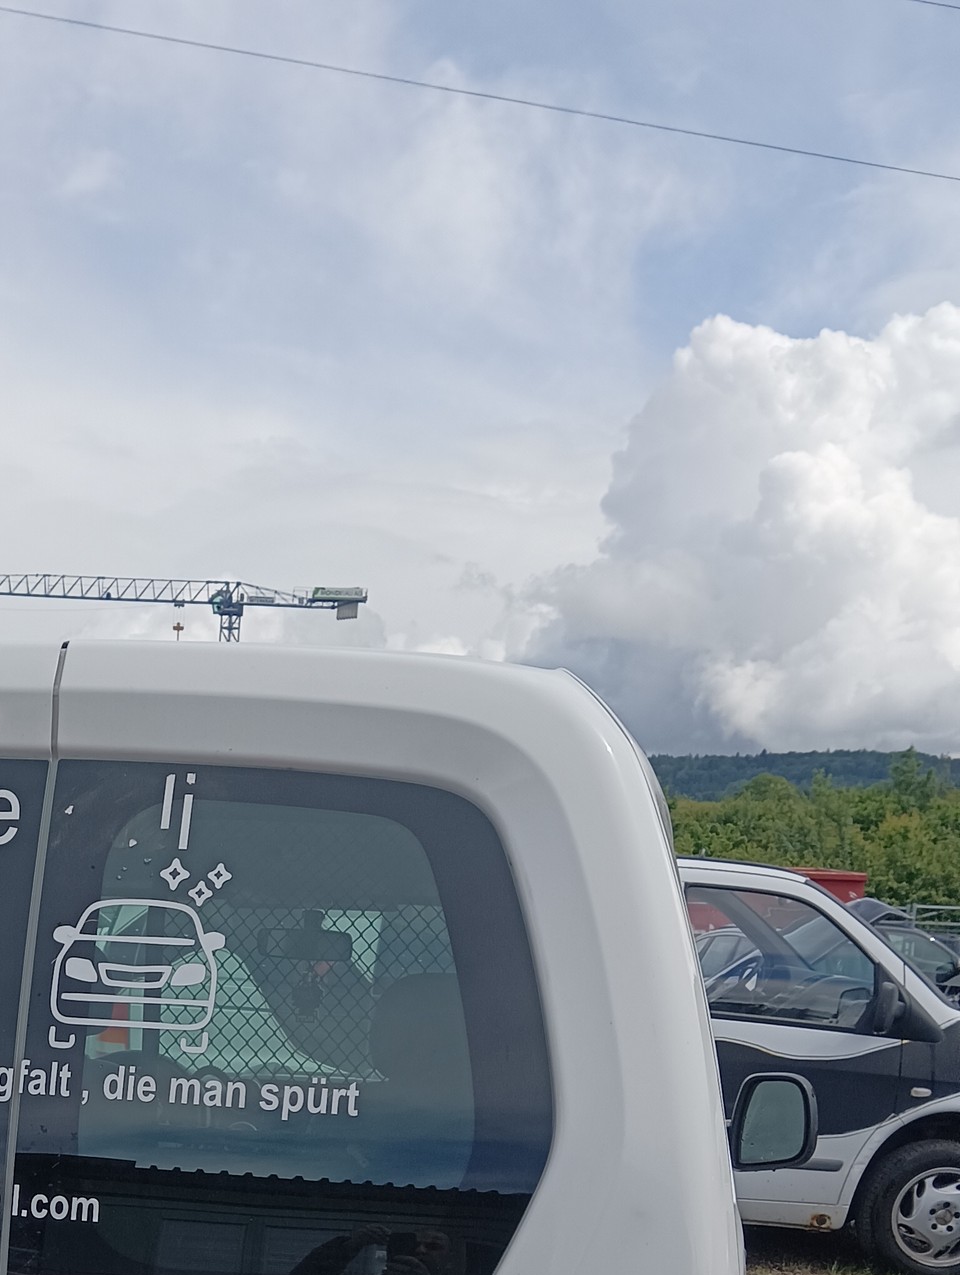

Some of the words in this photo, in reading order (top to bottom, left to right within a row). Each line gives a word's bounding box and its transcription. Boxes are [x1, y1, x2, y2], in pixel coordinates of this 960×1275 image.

[103, 1065, 158, 1104] die
[168, 1077, 247, 1110] man
[259, 1077, 361, 1122] spürt
